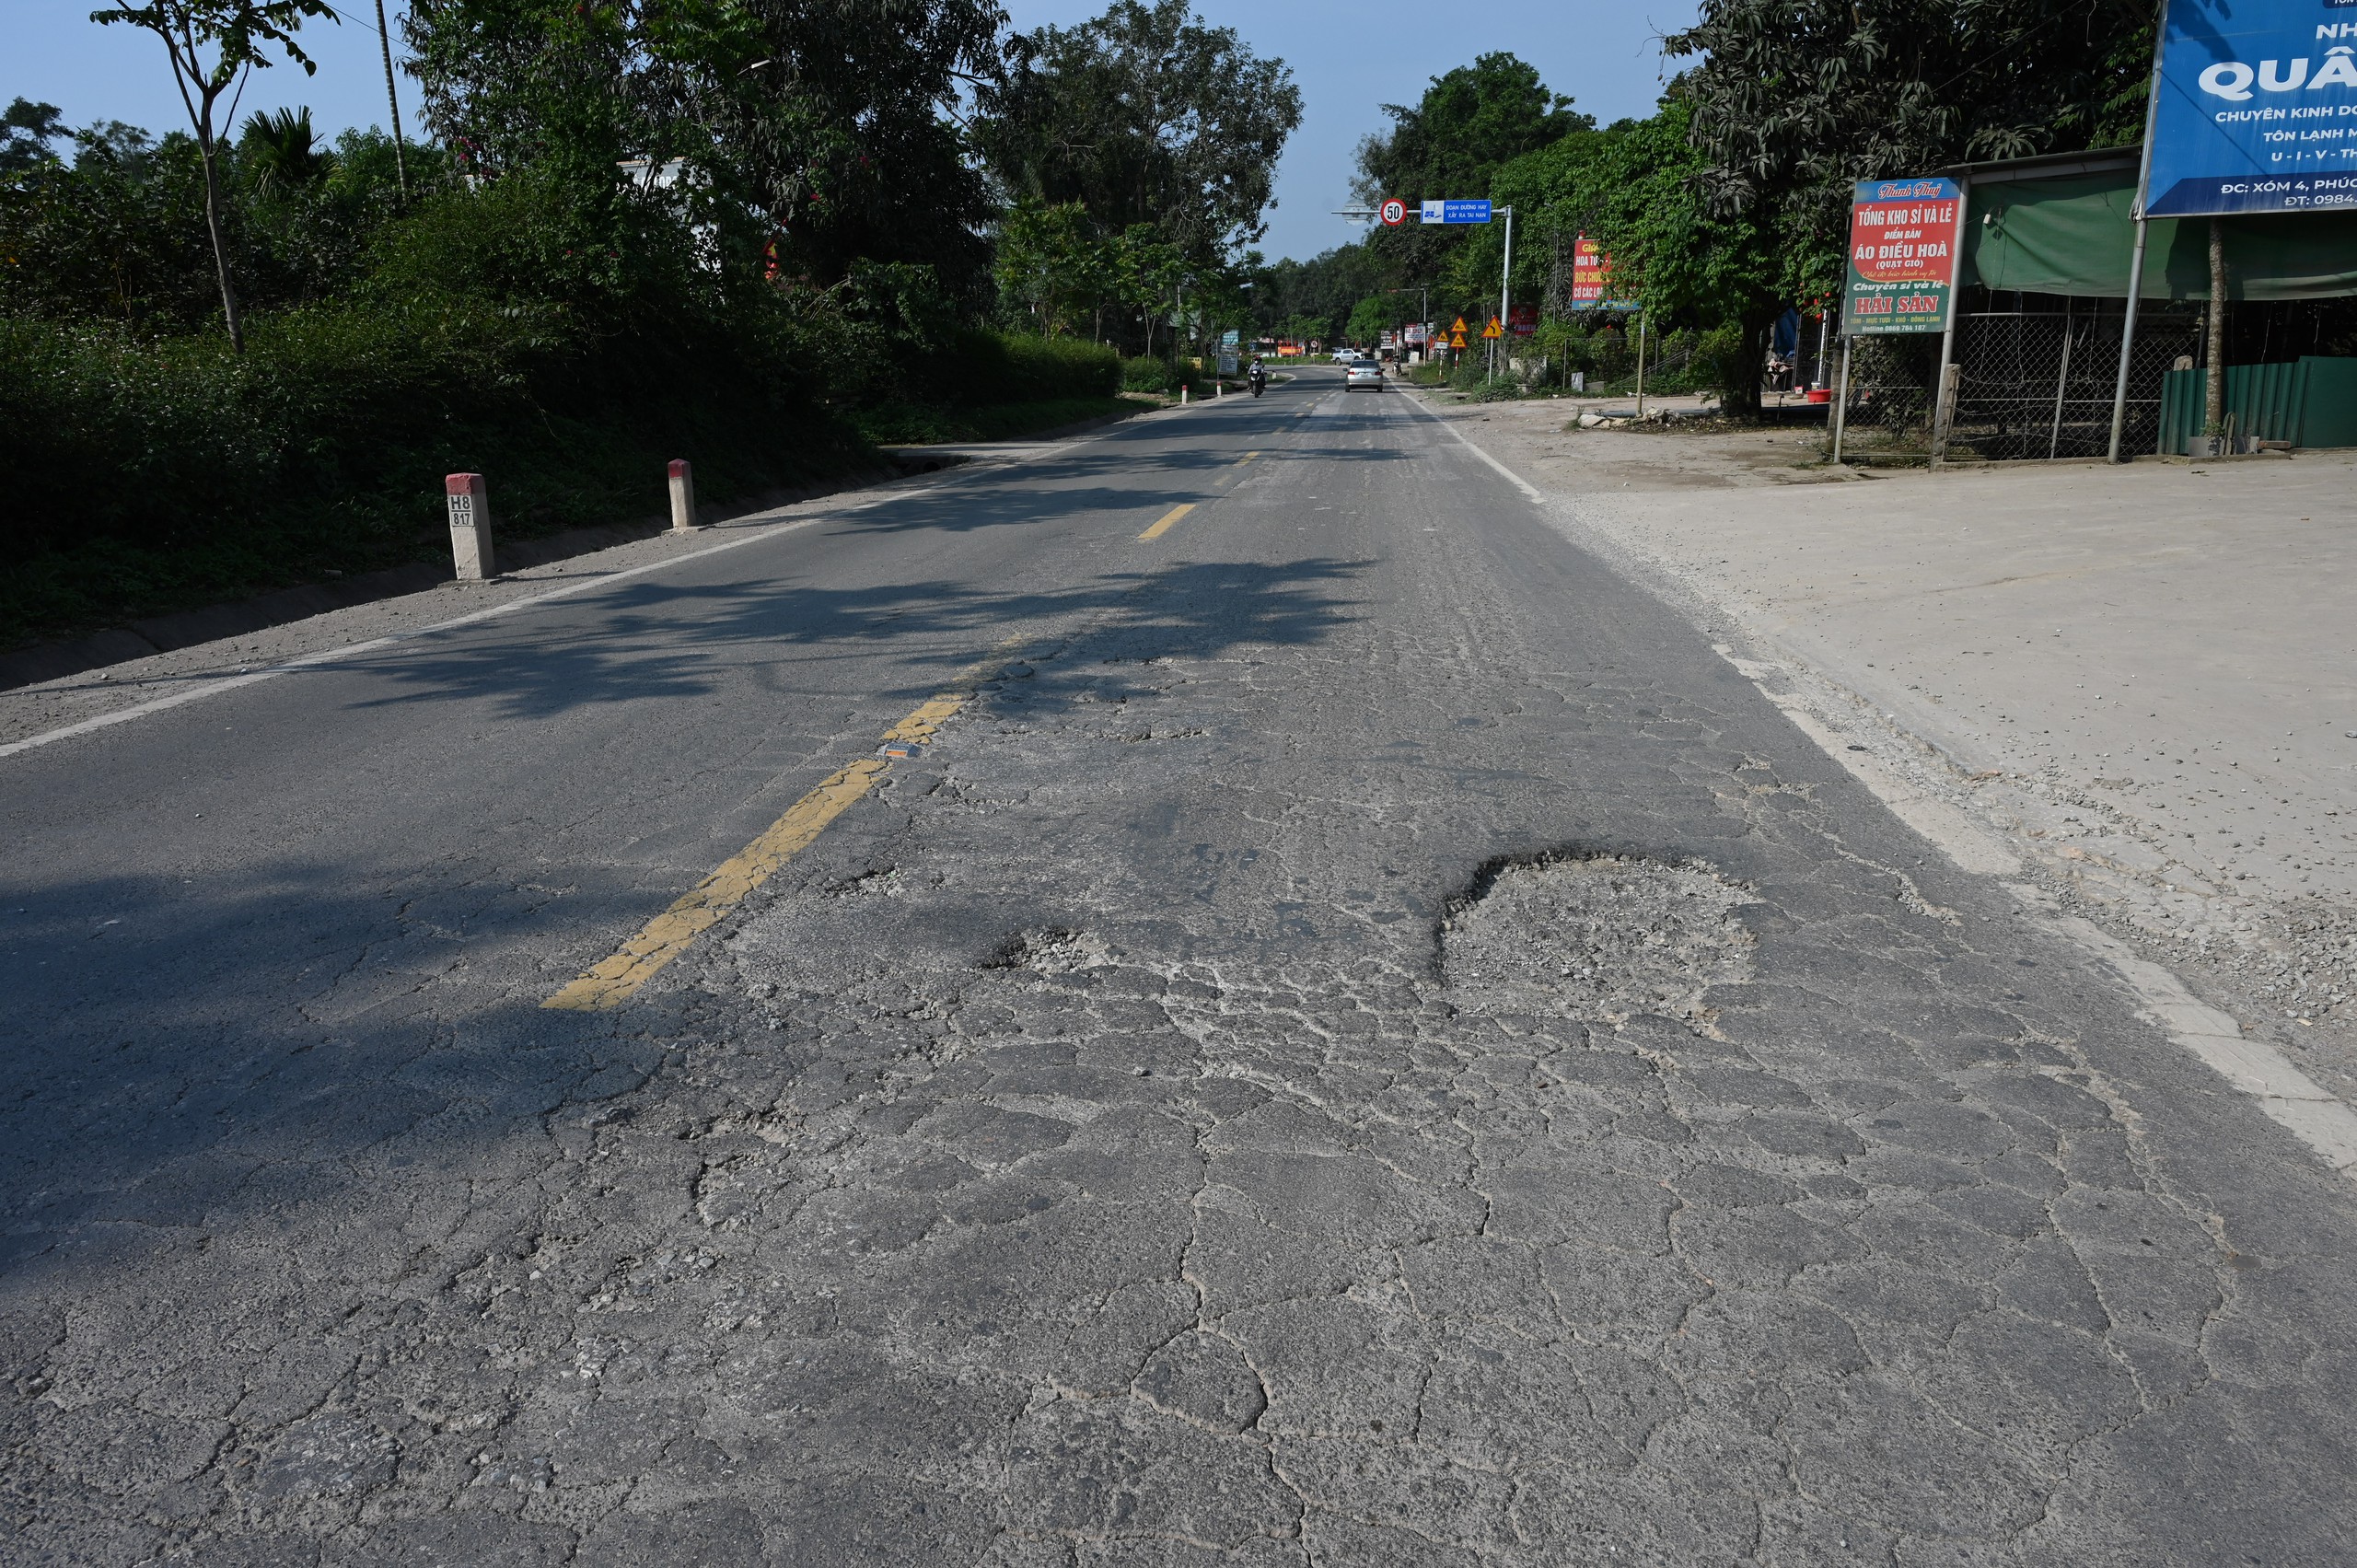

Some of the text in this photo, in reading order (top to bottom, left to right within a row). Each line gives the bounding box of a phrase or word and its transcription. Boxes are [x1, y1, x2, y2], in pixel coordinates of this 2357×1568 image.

[2215, 107, 2286, 122] CHUYÊN
[2291, 106, 2333, 118] KINH
[2263, 130, 2296, 142] TÔN
[2300, 128, 2344, 142] LẠNH
[2270, 152, 2282, 162] U
[1878, 183, 1911, 199] Thanh
[2221, 183, 2248, 194] ĐC:
[2252, 180, 2291, 193] XÓM
[2294, 180, 2309, 192] 4,
[2283, 195, 2310, 206] ĐT:
[1387, 205, 1399, 220] 50
[1858, 203, 1953, 226] TỔNG KHO SỈ VÀ LẺ
[1884, 226, 1922, 240] ĐIỂM BÁN
[1854, 240, 1947, 260] ÁO ĐIỀU HOÀ
[1575, 256, 1588, 266] HOA
[1875, 259, 1924, 270] (QUẠT GIÓ)
[1582, 285, 1593, 297] CÁC
[1852, 282, 1897, 292] Chuyên
[1899, 280, 1911, 290] sỉ
[1913, 280, 1930, 289] và
[1854, 291, 1939, 314] HẢI SẢN
[451, 496, 470, 509] H8
[453, 513, 470, 525] 817
